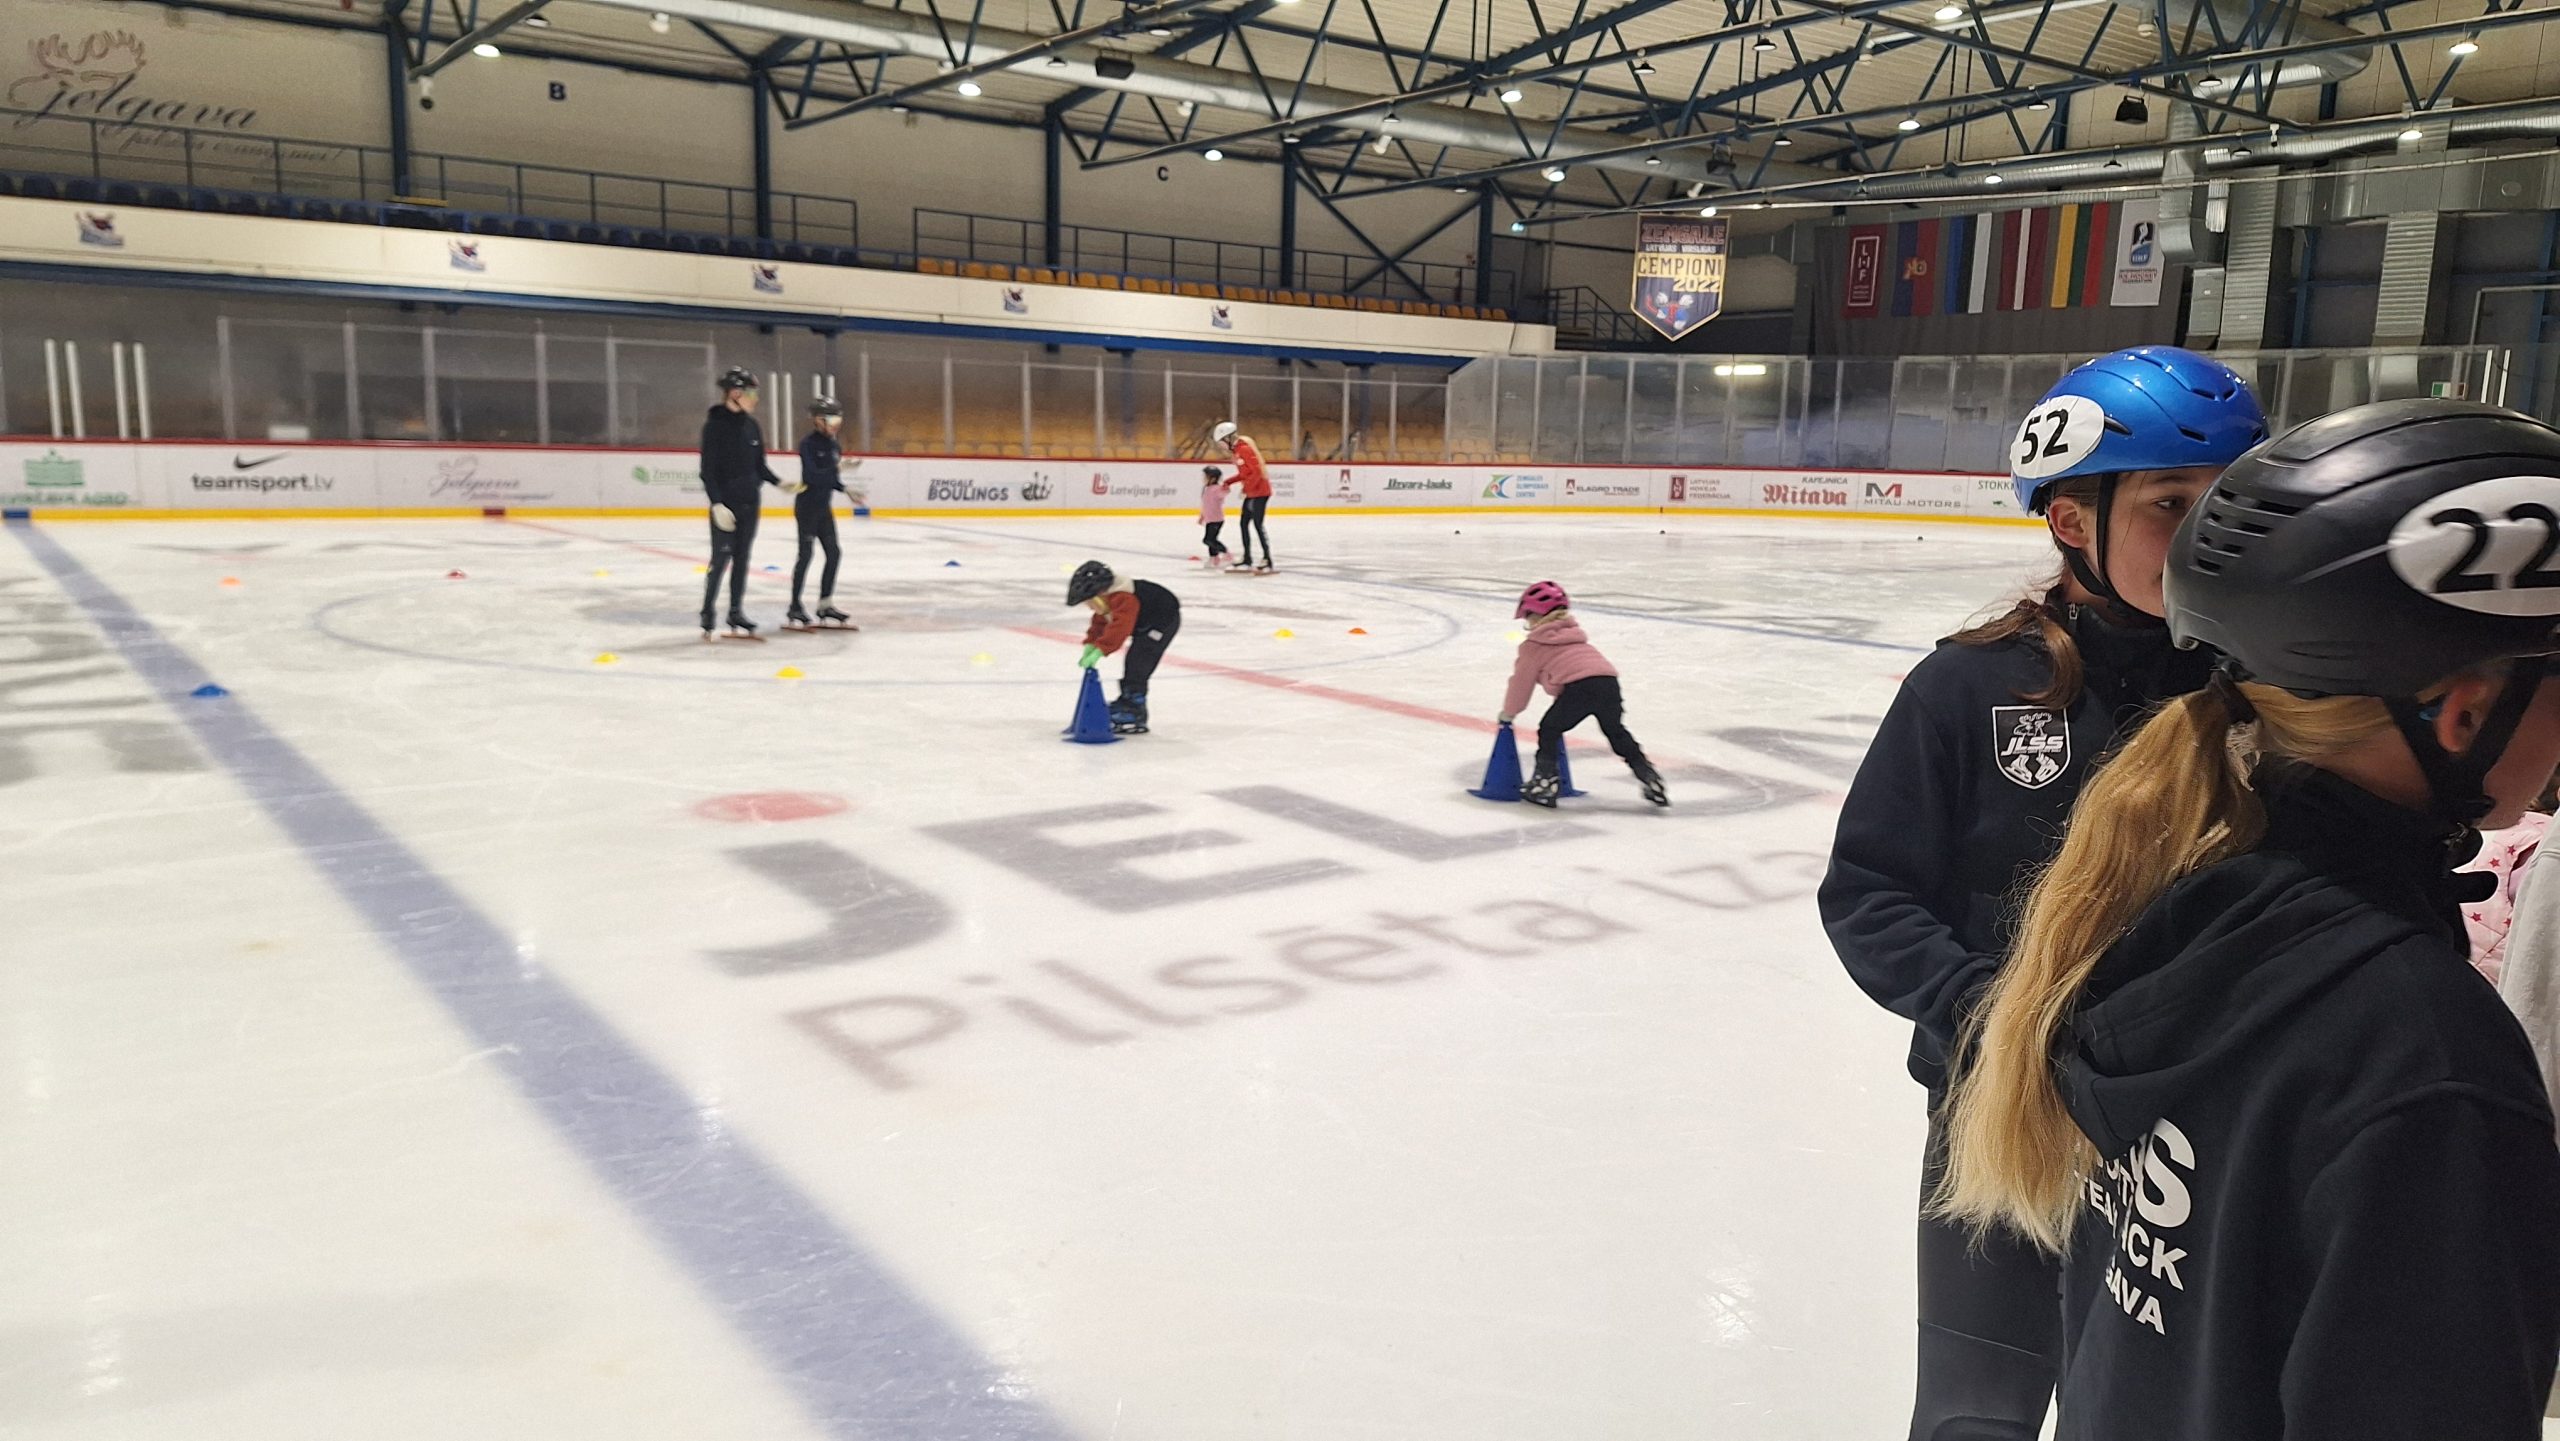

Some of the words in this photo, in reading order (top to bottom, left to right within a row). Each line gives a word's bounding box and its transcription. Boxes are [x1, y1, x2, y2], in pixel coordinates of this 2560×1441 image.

[549, 81, 566, 100] B
[1157, 165, 1169, 182] C
[1672, 278, 1721, 293] 2022
[2021, 408, 2069, 465] 52
[191, 473, 334, 494] teamsport.lv
[928, 486, 1009, 501] BOULINGS
[1906, 499, 1962, 508] MOTORS
[2430, 502, 2560, 594] 22
[2000, 735, 2064, 757] JLSS
